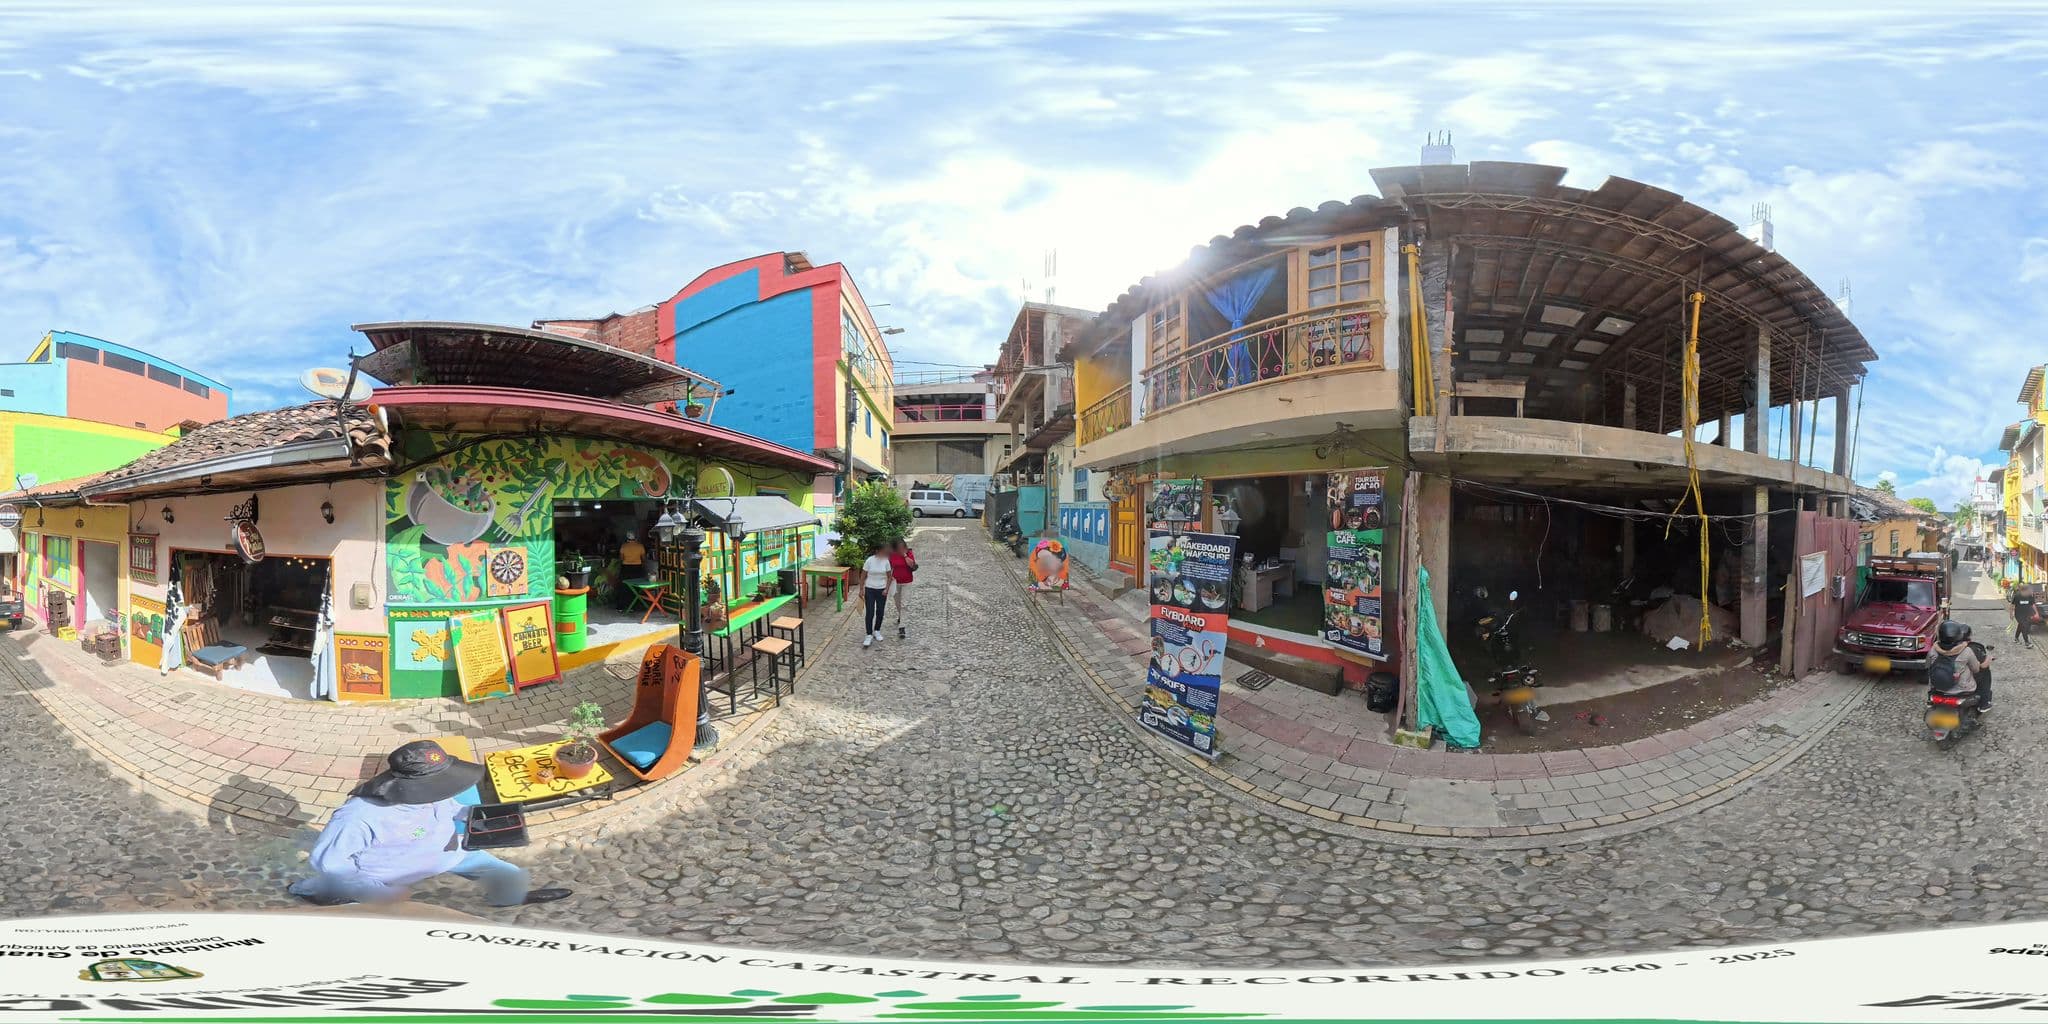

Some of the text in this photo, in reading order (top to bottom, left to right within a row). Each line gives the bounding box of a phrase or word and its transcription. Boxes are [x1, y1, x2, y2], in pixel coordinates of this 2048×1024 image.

[1180, 541, 1231, 554] WAKEBOARD
[1161, 606, 1206, 627] FLYBOARD
[521, 638, 542, 650] BEER
[504, 755, 533, 793] BELLA
